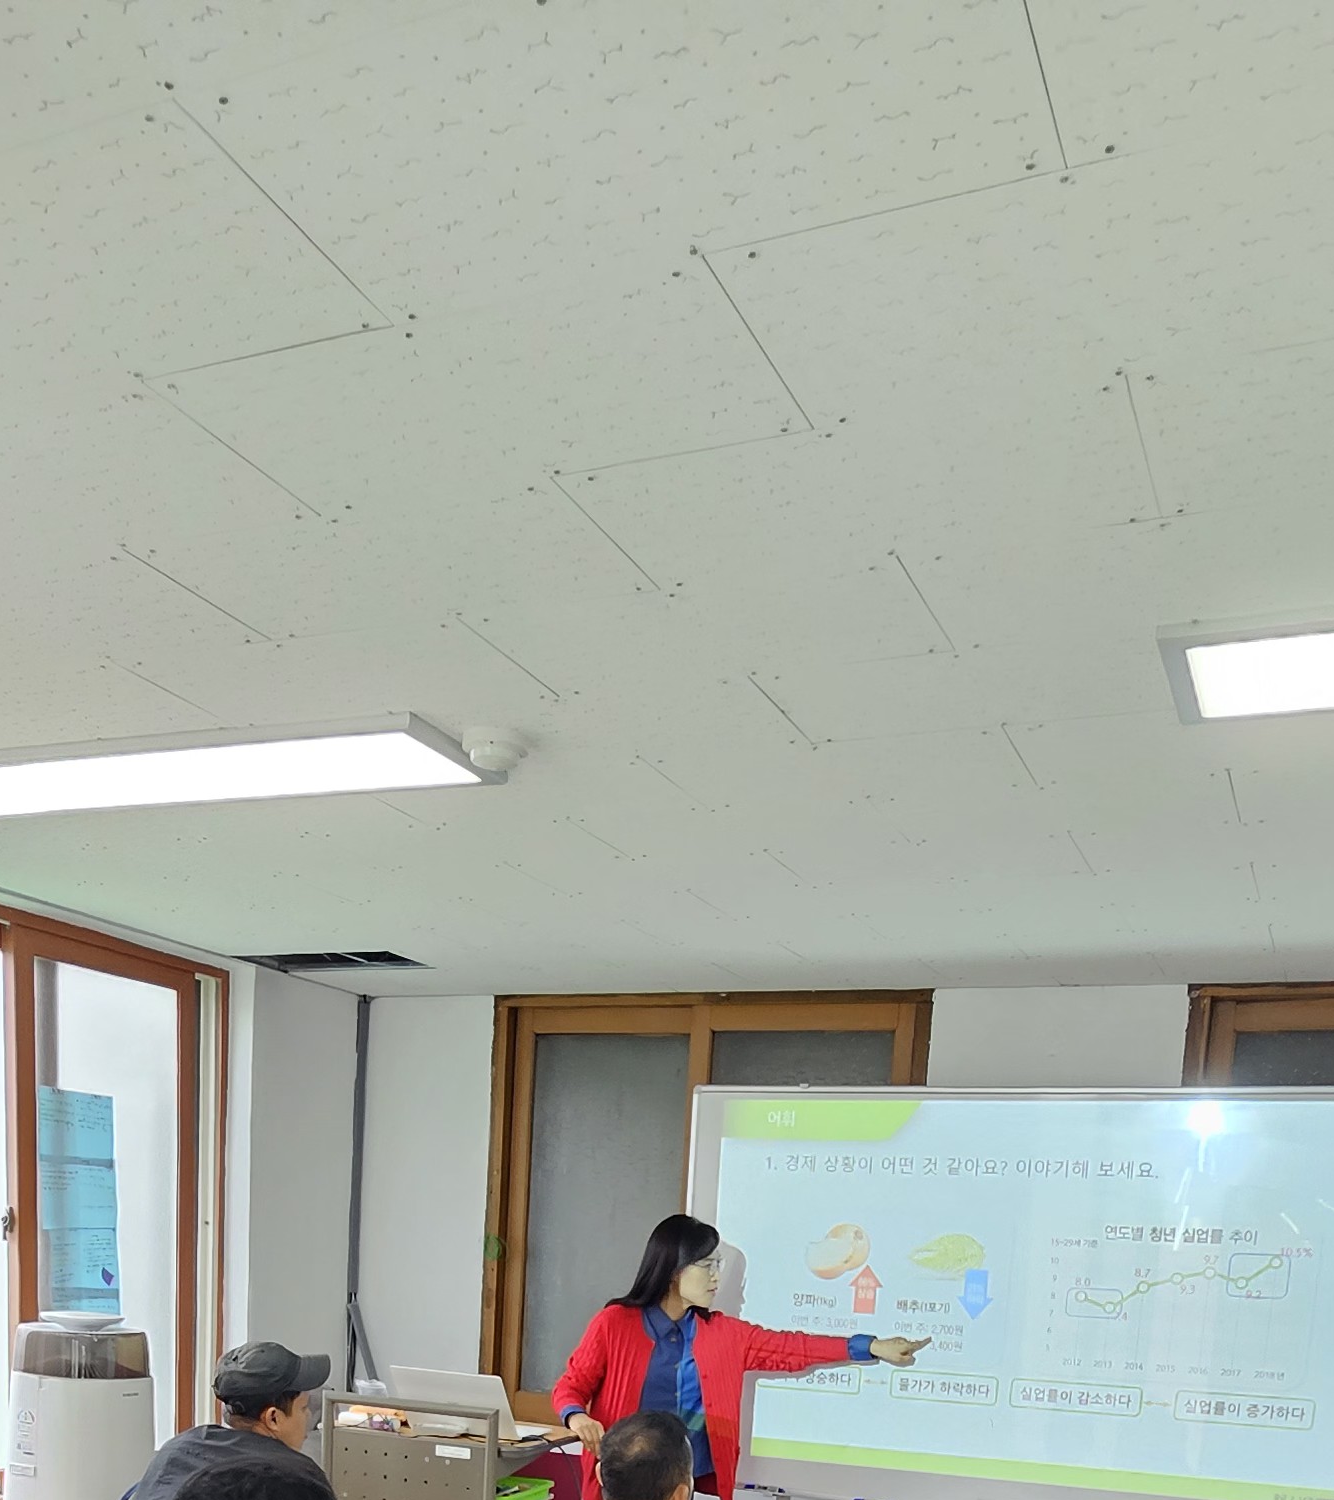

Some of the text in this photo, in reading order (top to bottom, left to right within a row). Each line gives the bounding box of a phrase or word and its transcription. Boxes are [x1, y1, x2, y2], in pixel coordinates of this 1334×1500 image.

[768, 1110, 795, 1128] 어휘
[767, 1154, 1159, 1180] 1. 경제 상황이 어떤 것 같아요? 이야기해 보세요.
[1104, 1224, 1258, 1245] 연도별 청년 실업률 추이
[1134, 1267, 1151, 1278] 8.7
[1180, 1285, 1196, 1295] 9.3
[793, 1293, 837, 1308] 양파(1kg)
[896, 1300, 950, 1314] 배추(1포기)
[894, 1321, 912, 1332] 이번
[1124, 1361, 1144, 1371] 2014
[1220, 1368, 1242, 1377] 2017
[898, 1377, 991, 1398] 물가가 하락하다
[1020, 1386, 1133, 1409] 실업률이 감소하다
[1184, 1399, 1306, 1421] 실업률이 증가하다
